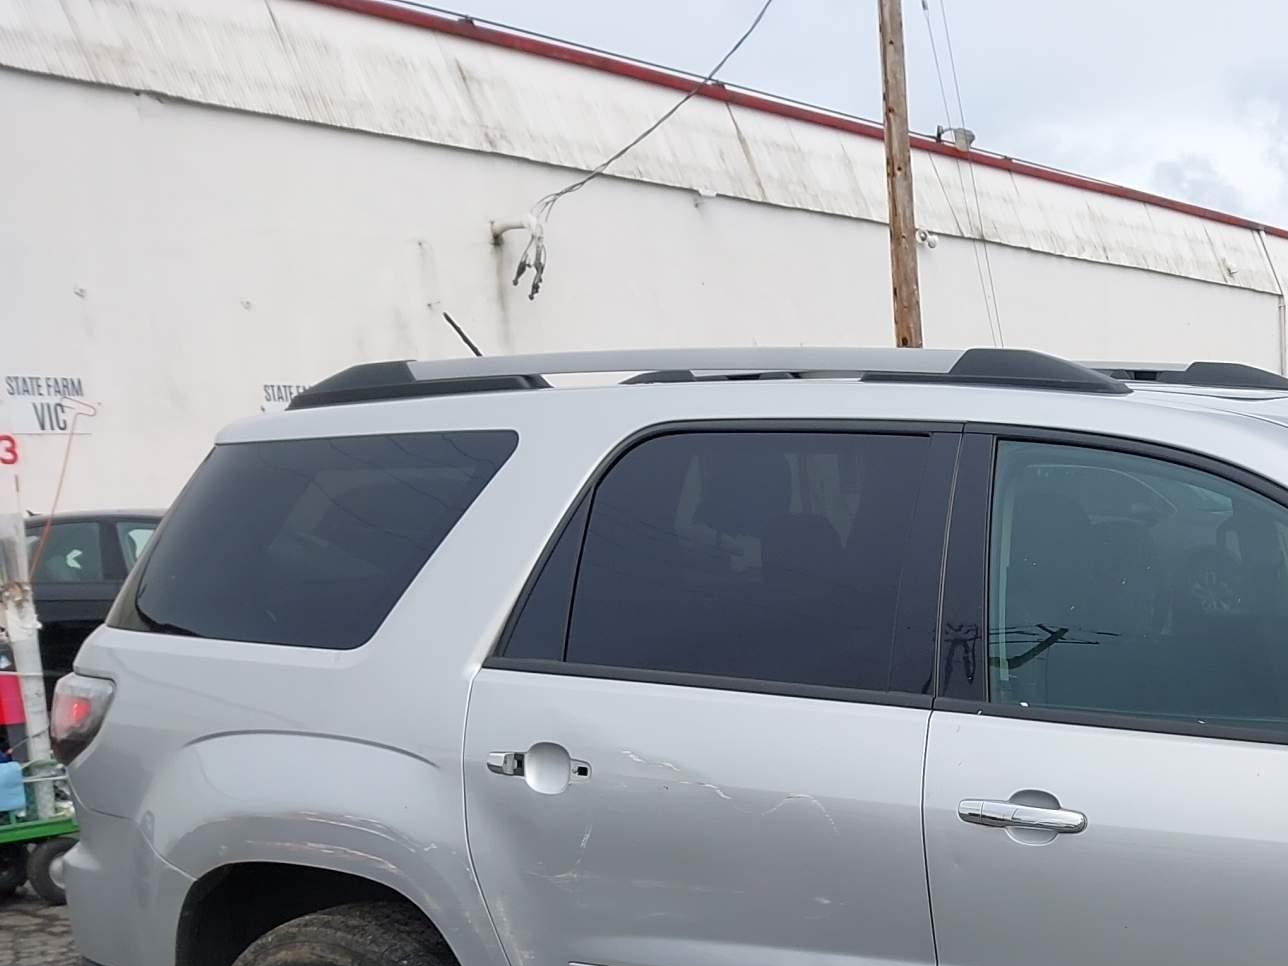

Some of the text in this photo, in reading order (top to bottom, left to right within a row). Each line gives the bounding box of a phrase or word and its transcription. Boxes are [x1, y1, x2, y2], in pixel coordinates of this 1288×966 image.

[5, 376, 84, 397] STATE FARM
[32, 402, 67, 431] VIC
